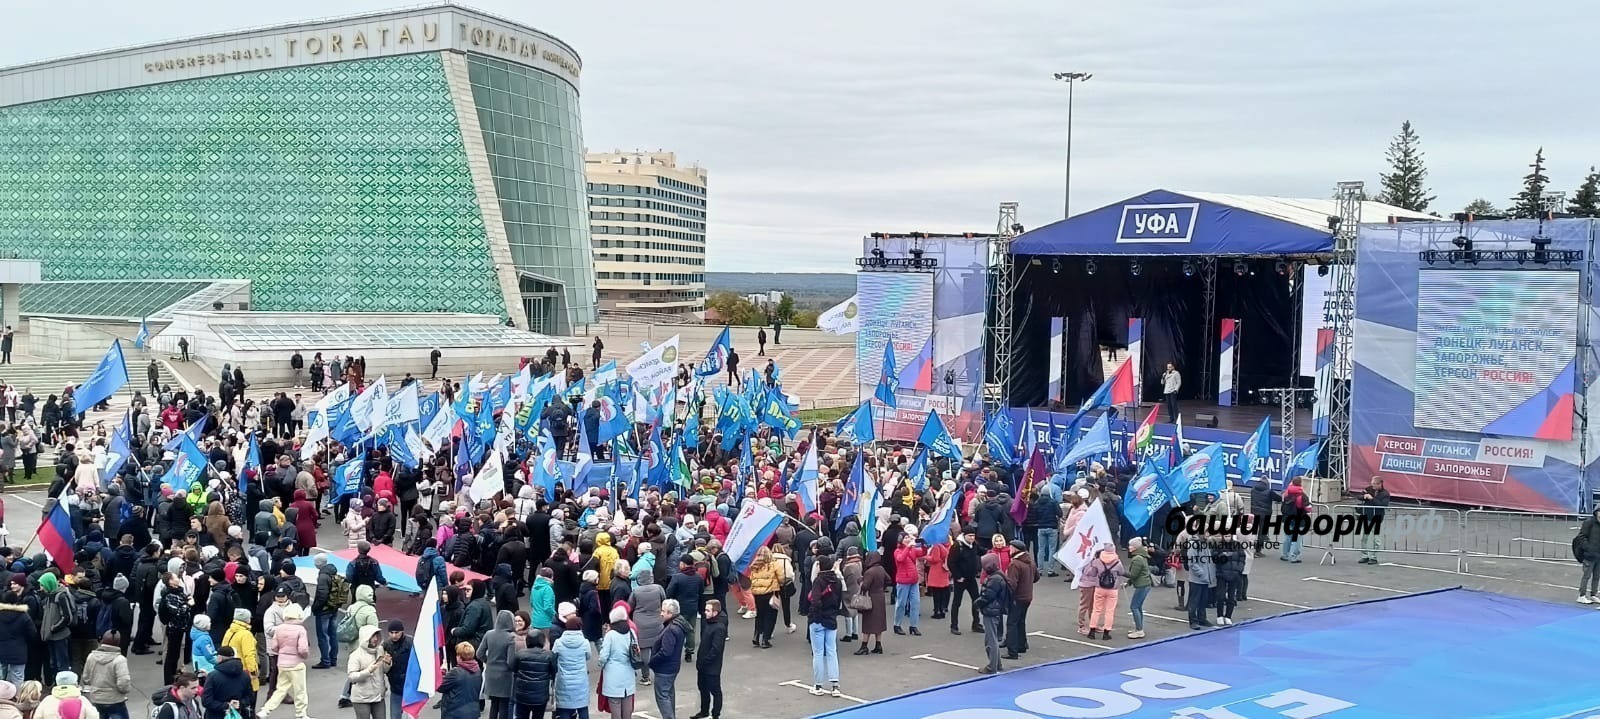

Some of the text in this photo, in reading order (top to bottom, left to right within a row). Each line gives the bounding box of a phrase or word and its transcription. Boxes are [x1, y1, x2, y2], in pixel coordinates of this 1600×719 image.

[284, 22, 438, 58] TORATAU
[1135, 212, 1179, 234] УФА
[1434, 337, 1546, 352] ДОНЕЦК, ЛУГАНСК,
[1482, 369, 1533, 383] РОССИЯ!
[1383, 440, 1534, 459] ХЕРСОН ЛУГАНСК РОССИЯ!
[1386, 458, 1491, 477] ДОНЕЦК ЗАПОРОЖЬЕ
